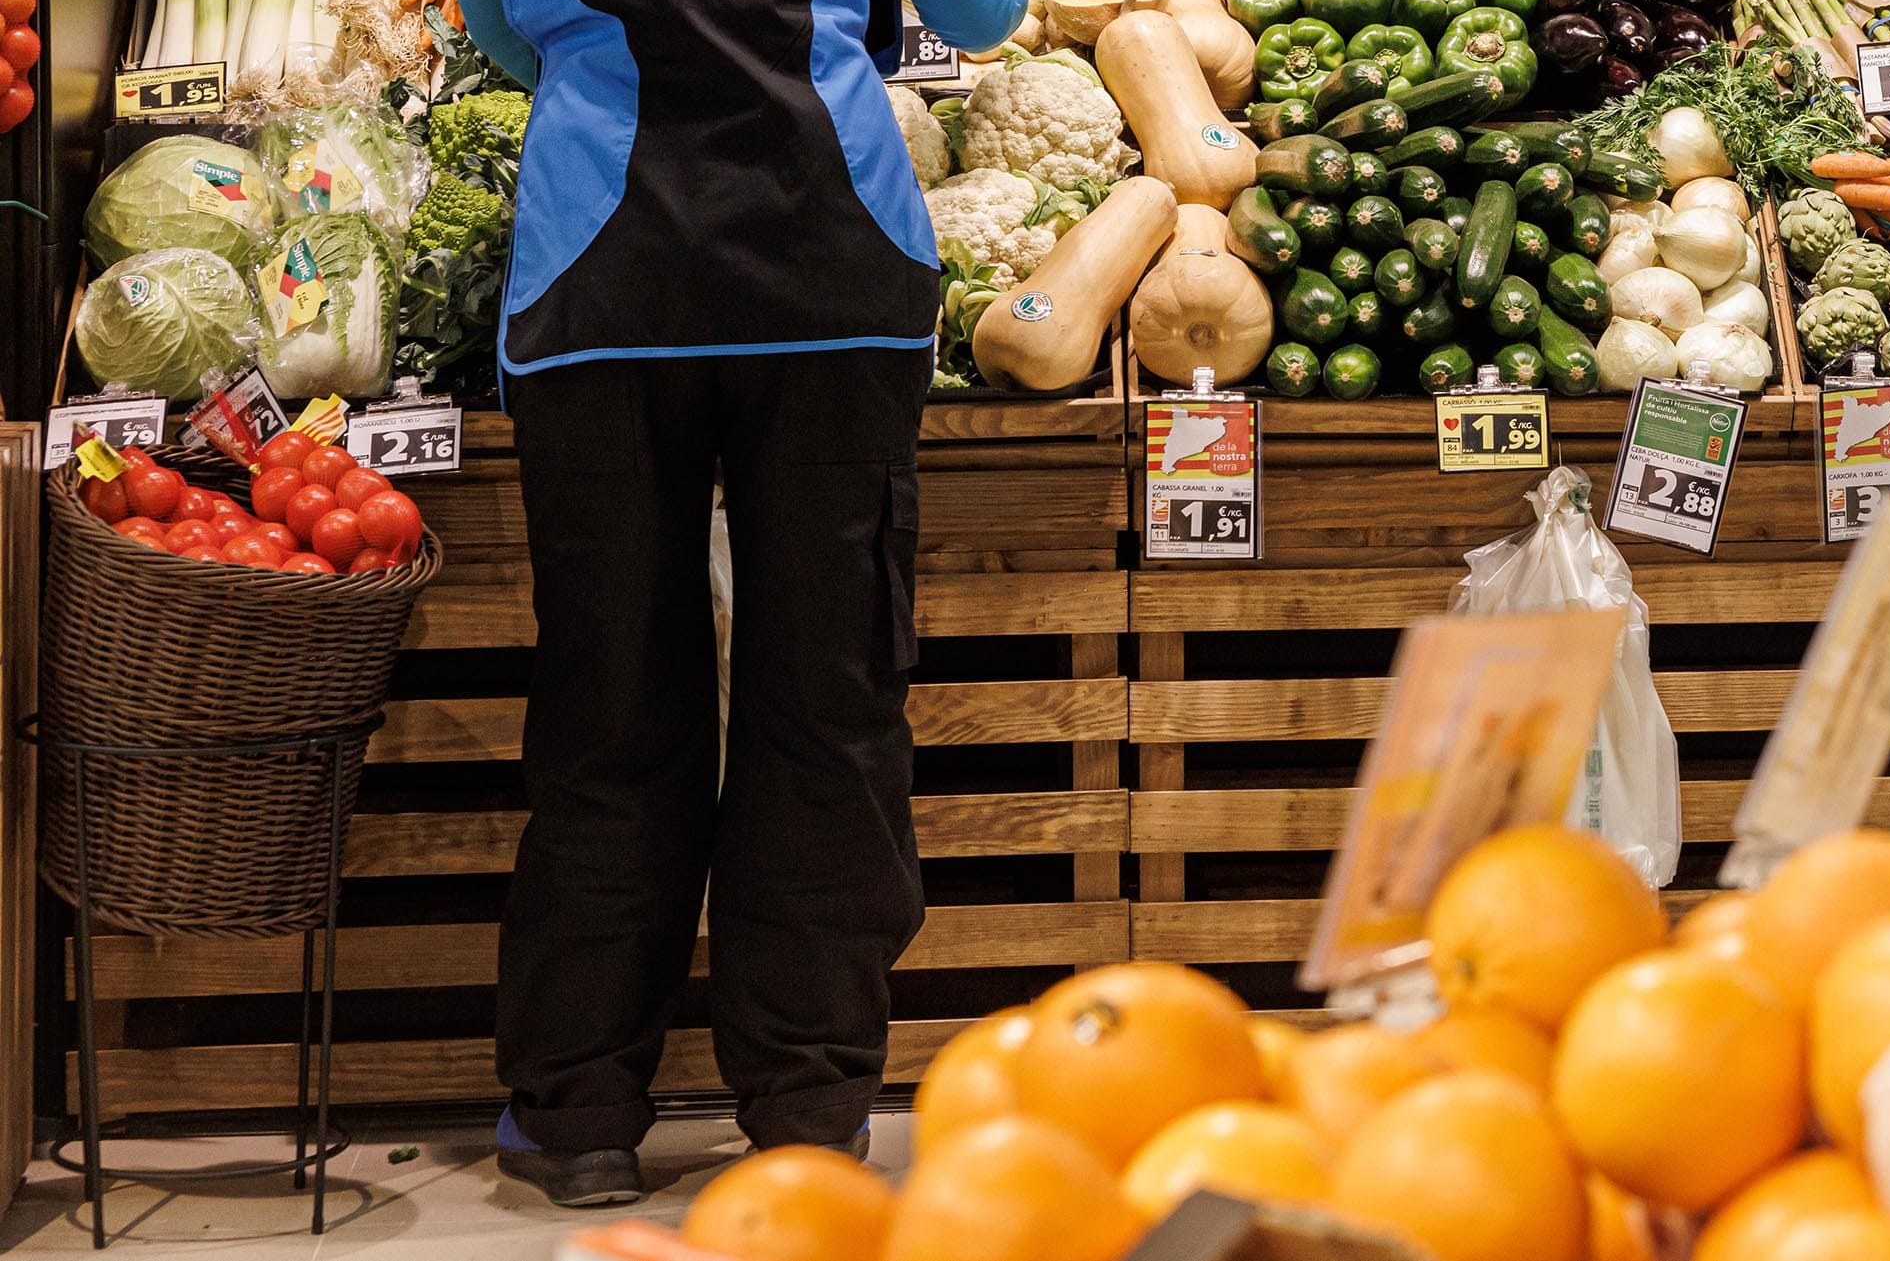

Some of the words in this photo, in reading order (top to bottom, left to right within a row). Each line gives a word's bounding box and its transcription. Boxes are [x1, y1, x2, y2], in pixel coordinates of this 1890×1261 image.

[150, 84, 218, 106] 1,95
[1644, 409, 1688, 425] responsable
[1471, 415, 1541, 453] 1,99
[381, 431, 454, 463] 2,16
[1213, 442, 1226, 451] de
[1227, 442, 1237, 450] la
[1212, 452, 1247, 462] nostra
[1212, 463, 1238, 471] terra
[1828, 472, 1858, 481] CARXOFA
[1860, 471, 1873, 479] 1,00
[1182, 484, 1208, 492] GRANEL
[1648, 469, 1715, 517] 2,88
[1624, 491, 1634, 500] 13
[1180, 501, 1246, 541] 1,91
[1835, 518, 1841, 526] 3
[1155, 531, 1165, 539] 11
